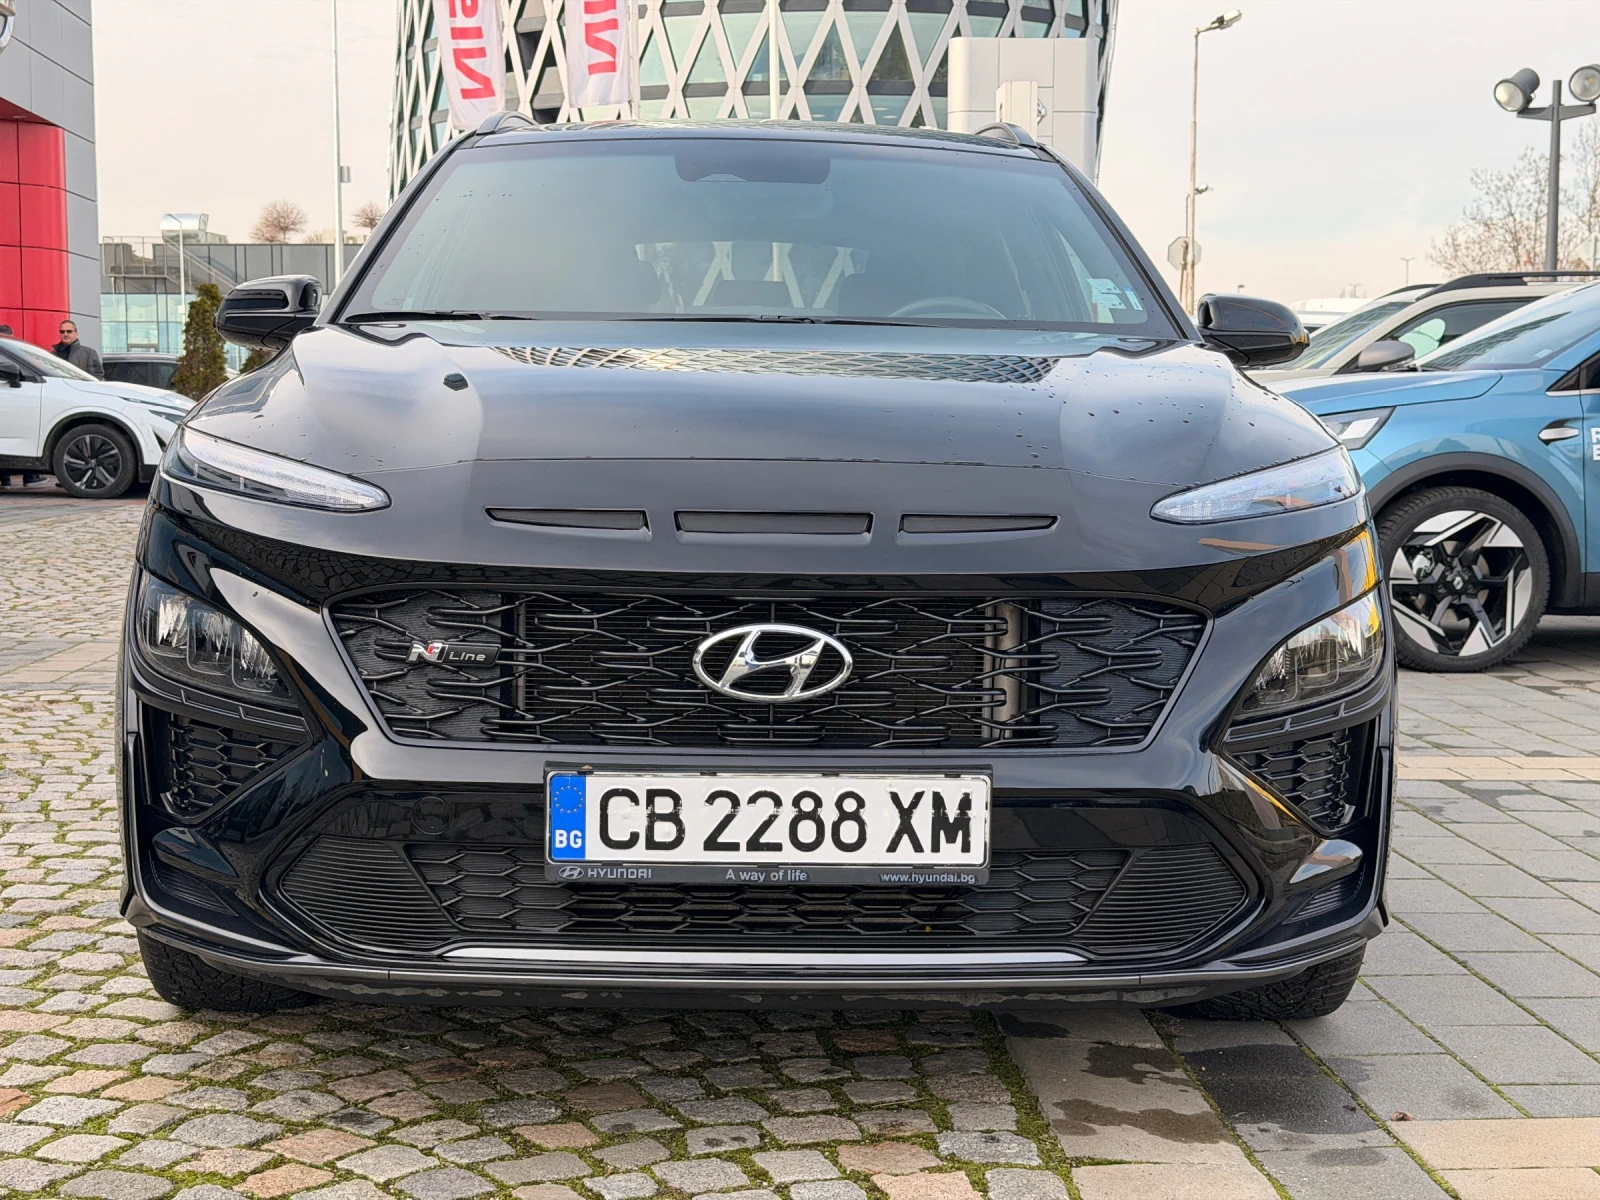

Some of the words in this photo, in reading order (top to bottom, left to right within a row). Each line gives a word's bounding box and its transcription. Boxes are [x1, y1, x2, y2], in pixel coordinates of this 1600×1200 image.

[449, 651, 486, 661] Line
[599, 788, 686, 851] CB
[703, 789, 867, 852] 2288
[885, 790, 972, 853] XM
[555, 829, 582, 848] BG
[587, 868, 652, 879] HYUNDAI
[725, 869, 736, 880] A
[739, 871, 766, 883] way
[770, 870, 784, 881] of
[788, 870, 808, 880] life
[880, 871, 976, 884] www.hyundai.bg
